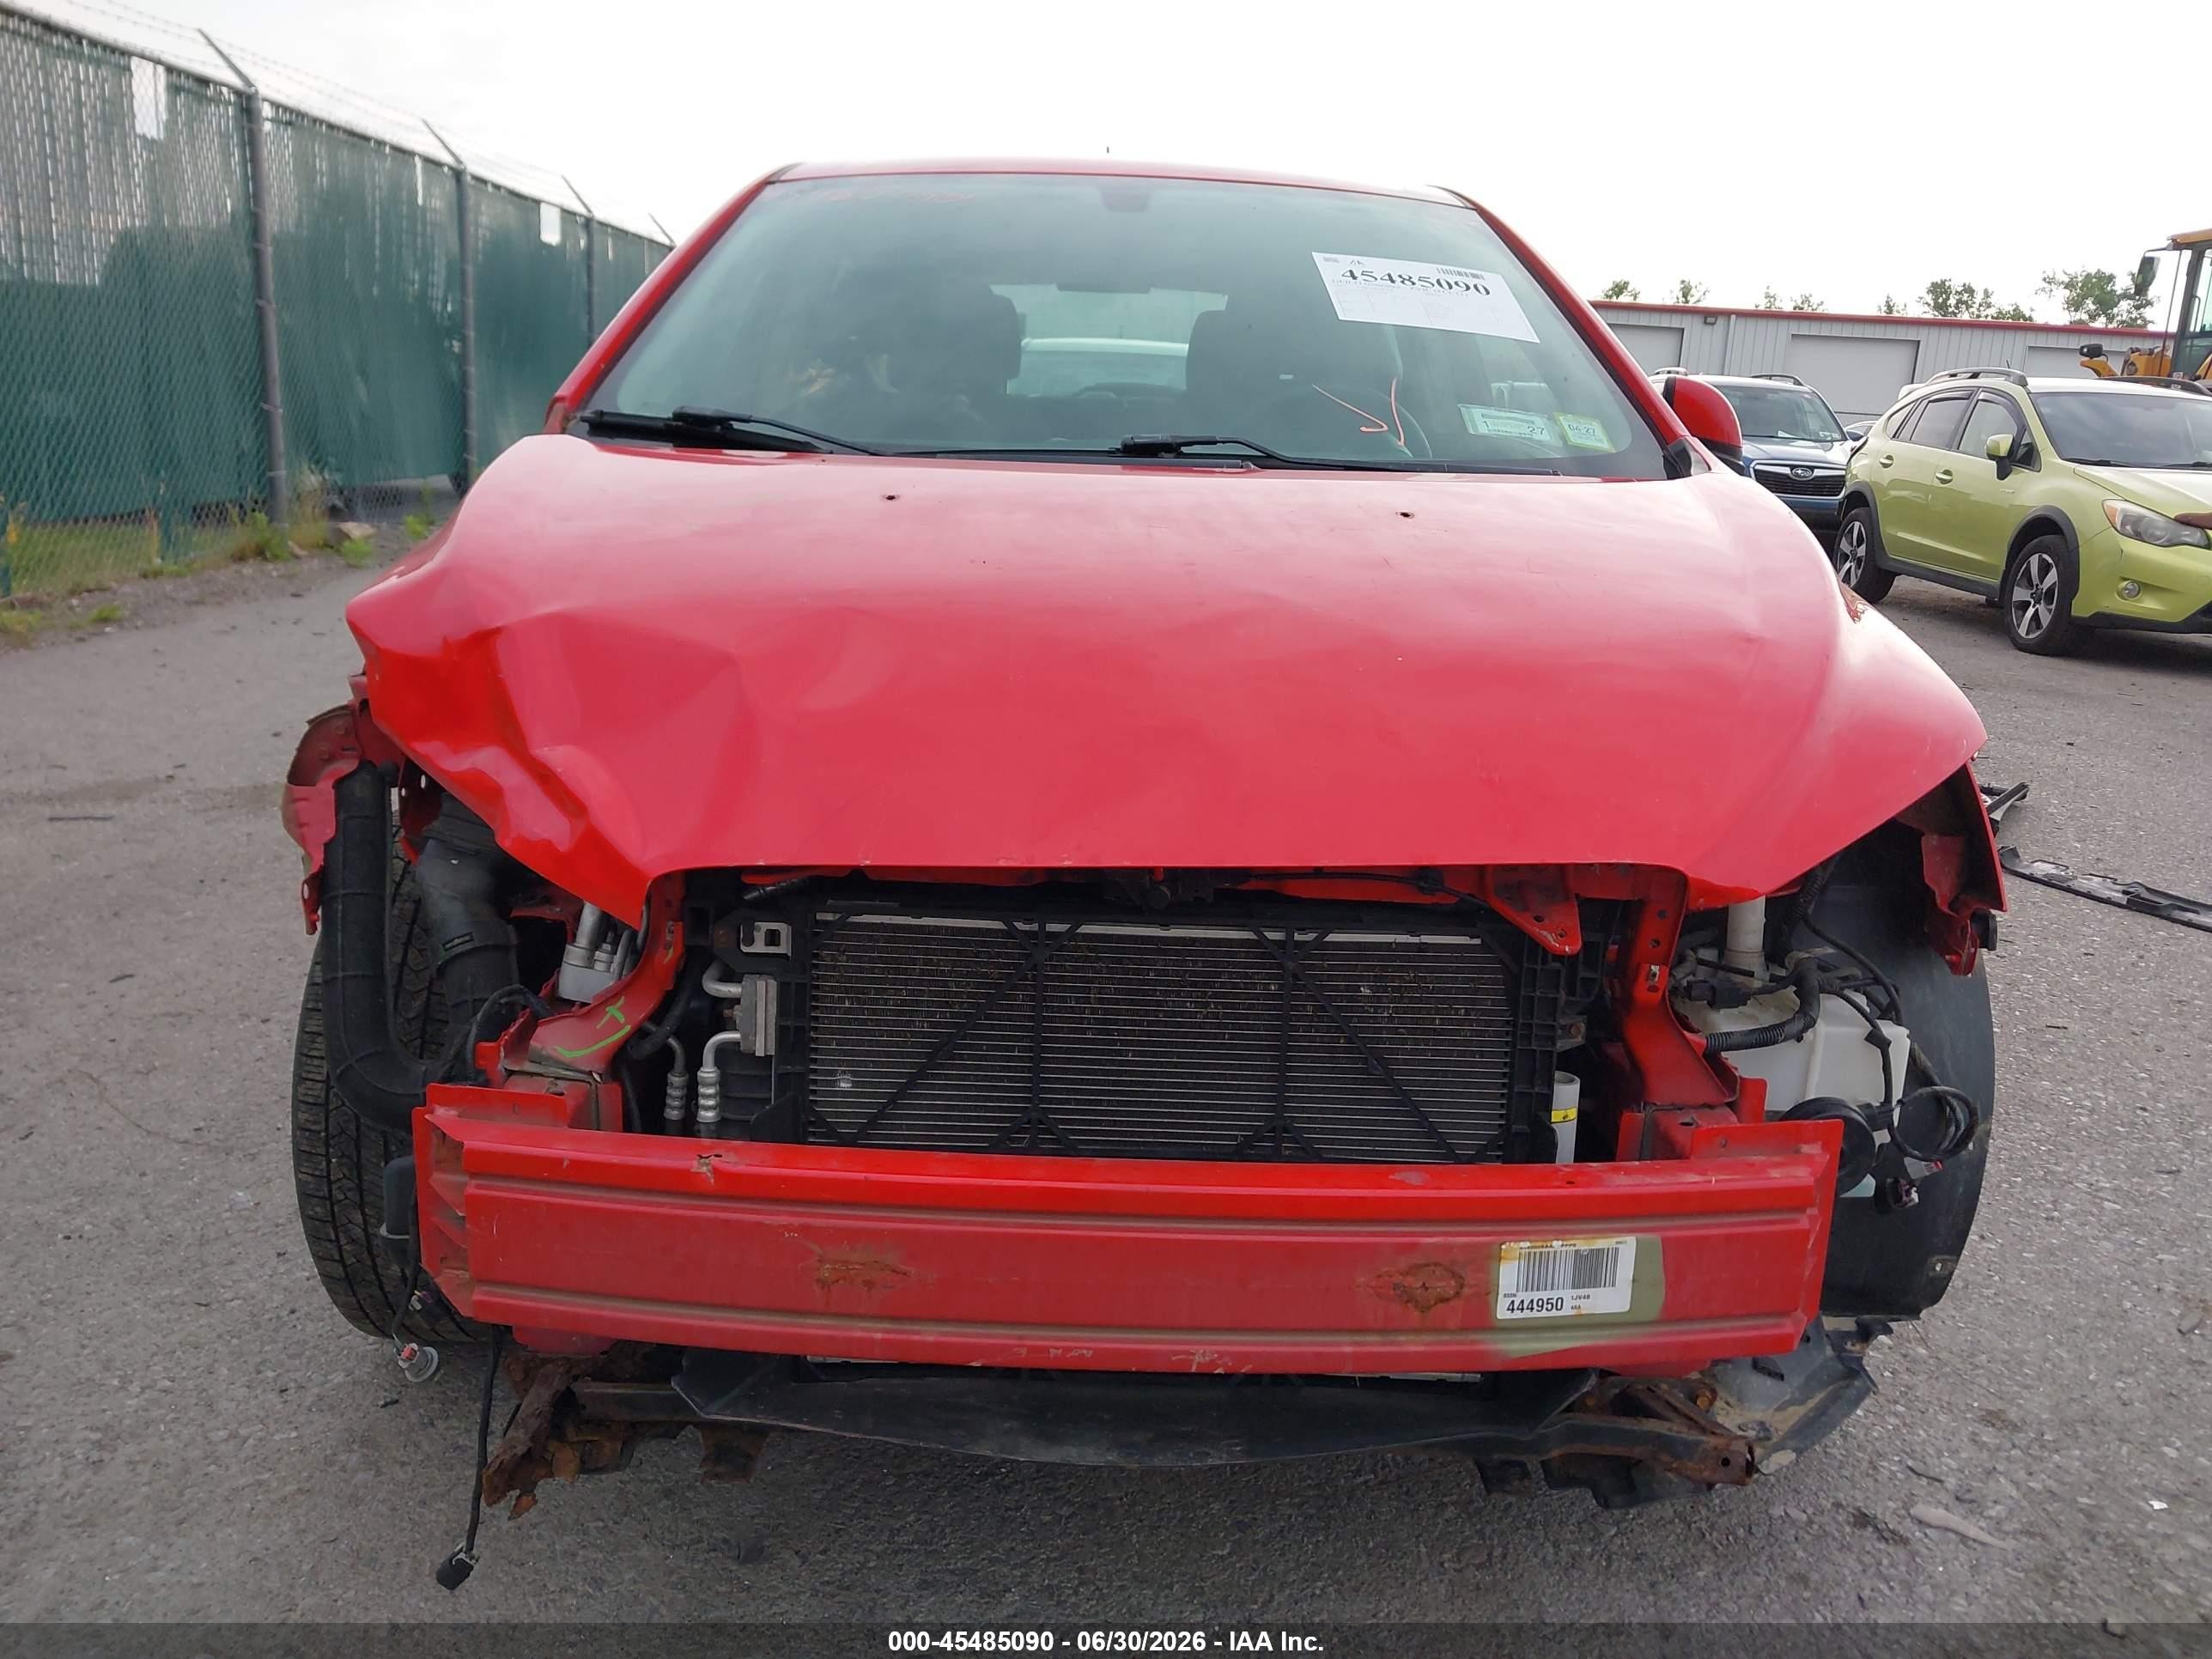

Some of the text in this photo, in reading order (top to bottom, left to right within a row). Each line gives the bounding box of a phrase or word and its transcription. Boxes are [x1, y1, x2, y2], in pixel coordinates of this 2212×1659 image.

[1341, 269, 1491, 296] 45485090
[1527, 425, 1545, 435] 27
[1506, 1297, 1565, 1314] 444950
